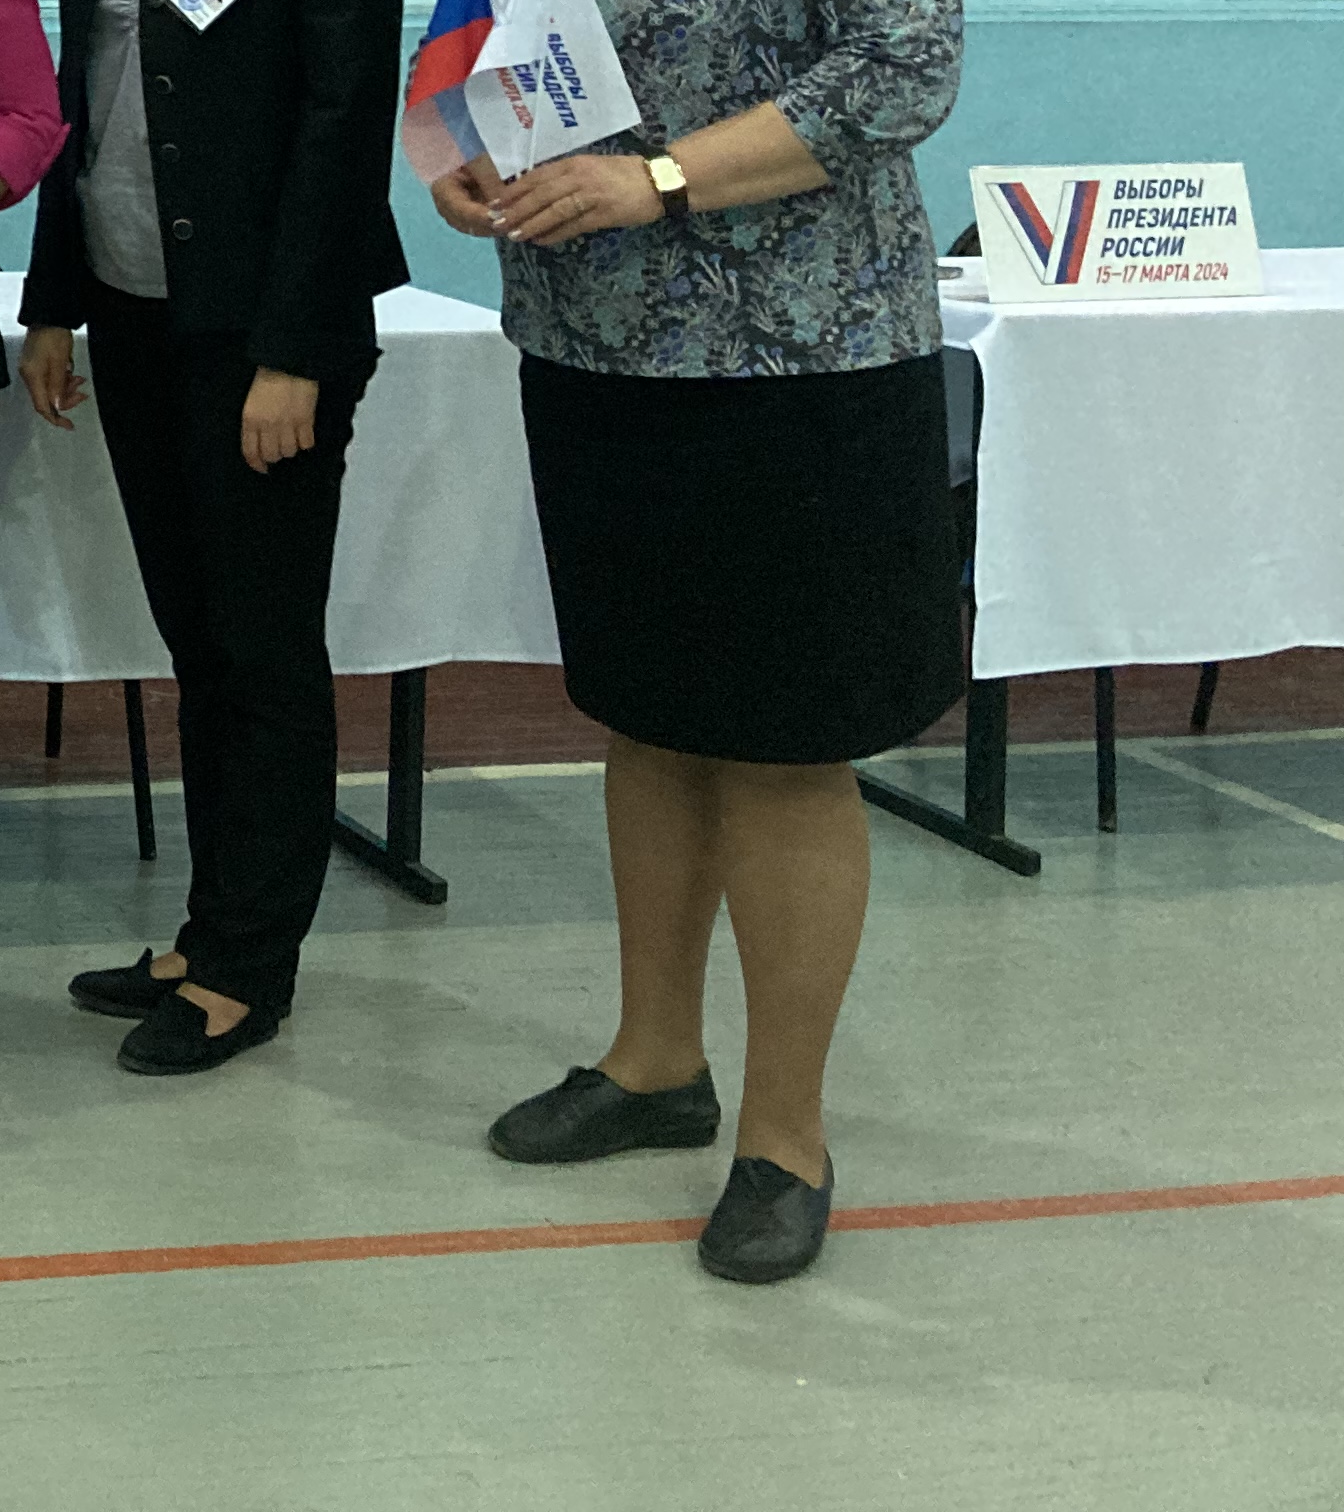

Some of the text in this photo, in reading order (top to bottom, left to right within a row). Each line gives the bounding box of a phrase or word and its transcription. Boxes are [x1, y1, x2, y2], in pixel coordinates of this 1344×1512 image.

[547, 33, 588, 99] ВЫБОРЫ
[1113, 178, 1204, 200] ВЫБОРЫ
[1106, 206, 1237, 230] ПРЕЗИДЕНТА
[1100, 236, 1185, 258] РОССИИ
[1139, 264, 1190, 283] МАРТА
[1193, 262, 1229, 282] 2024
